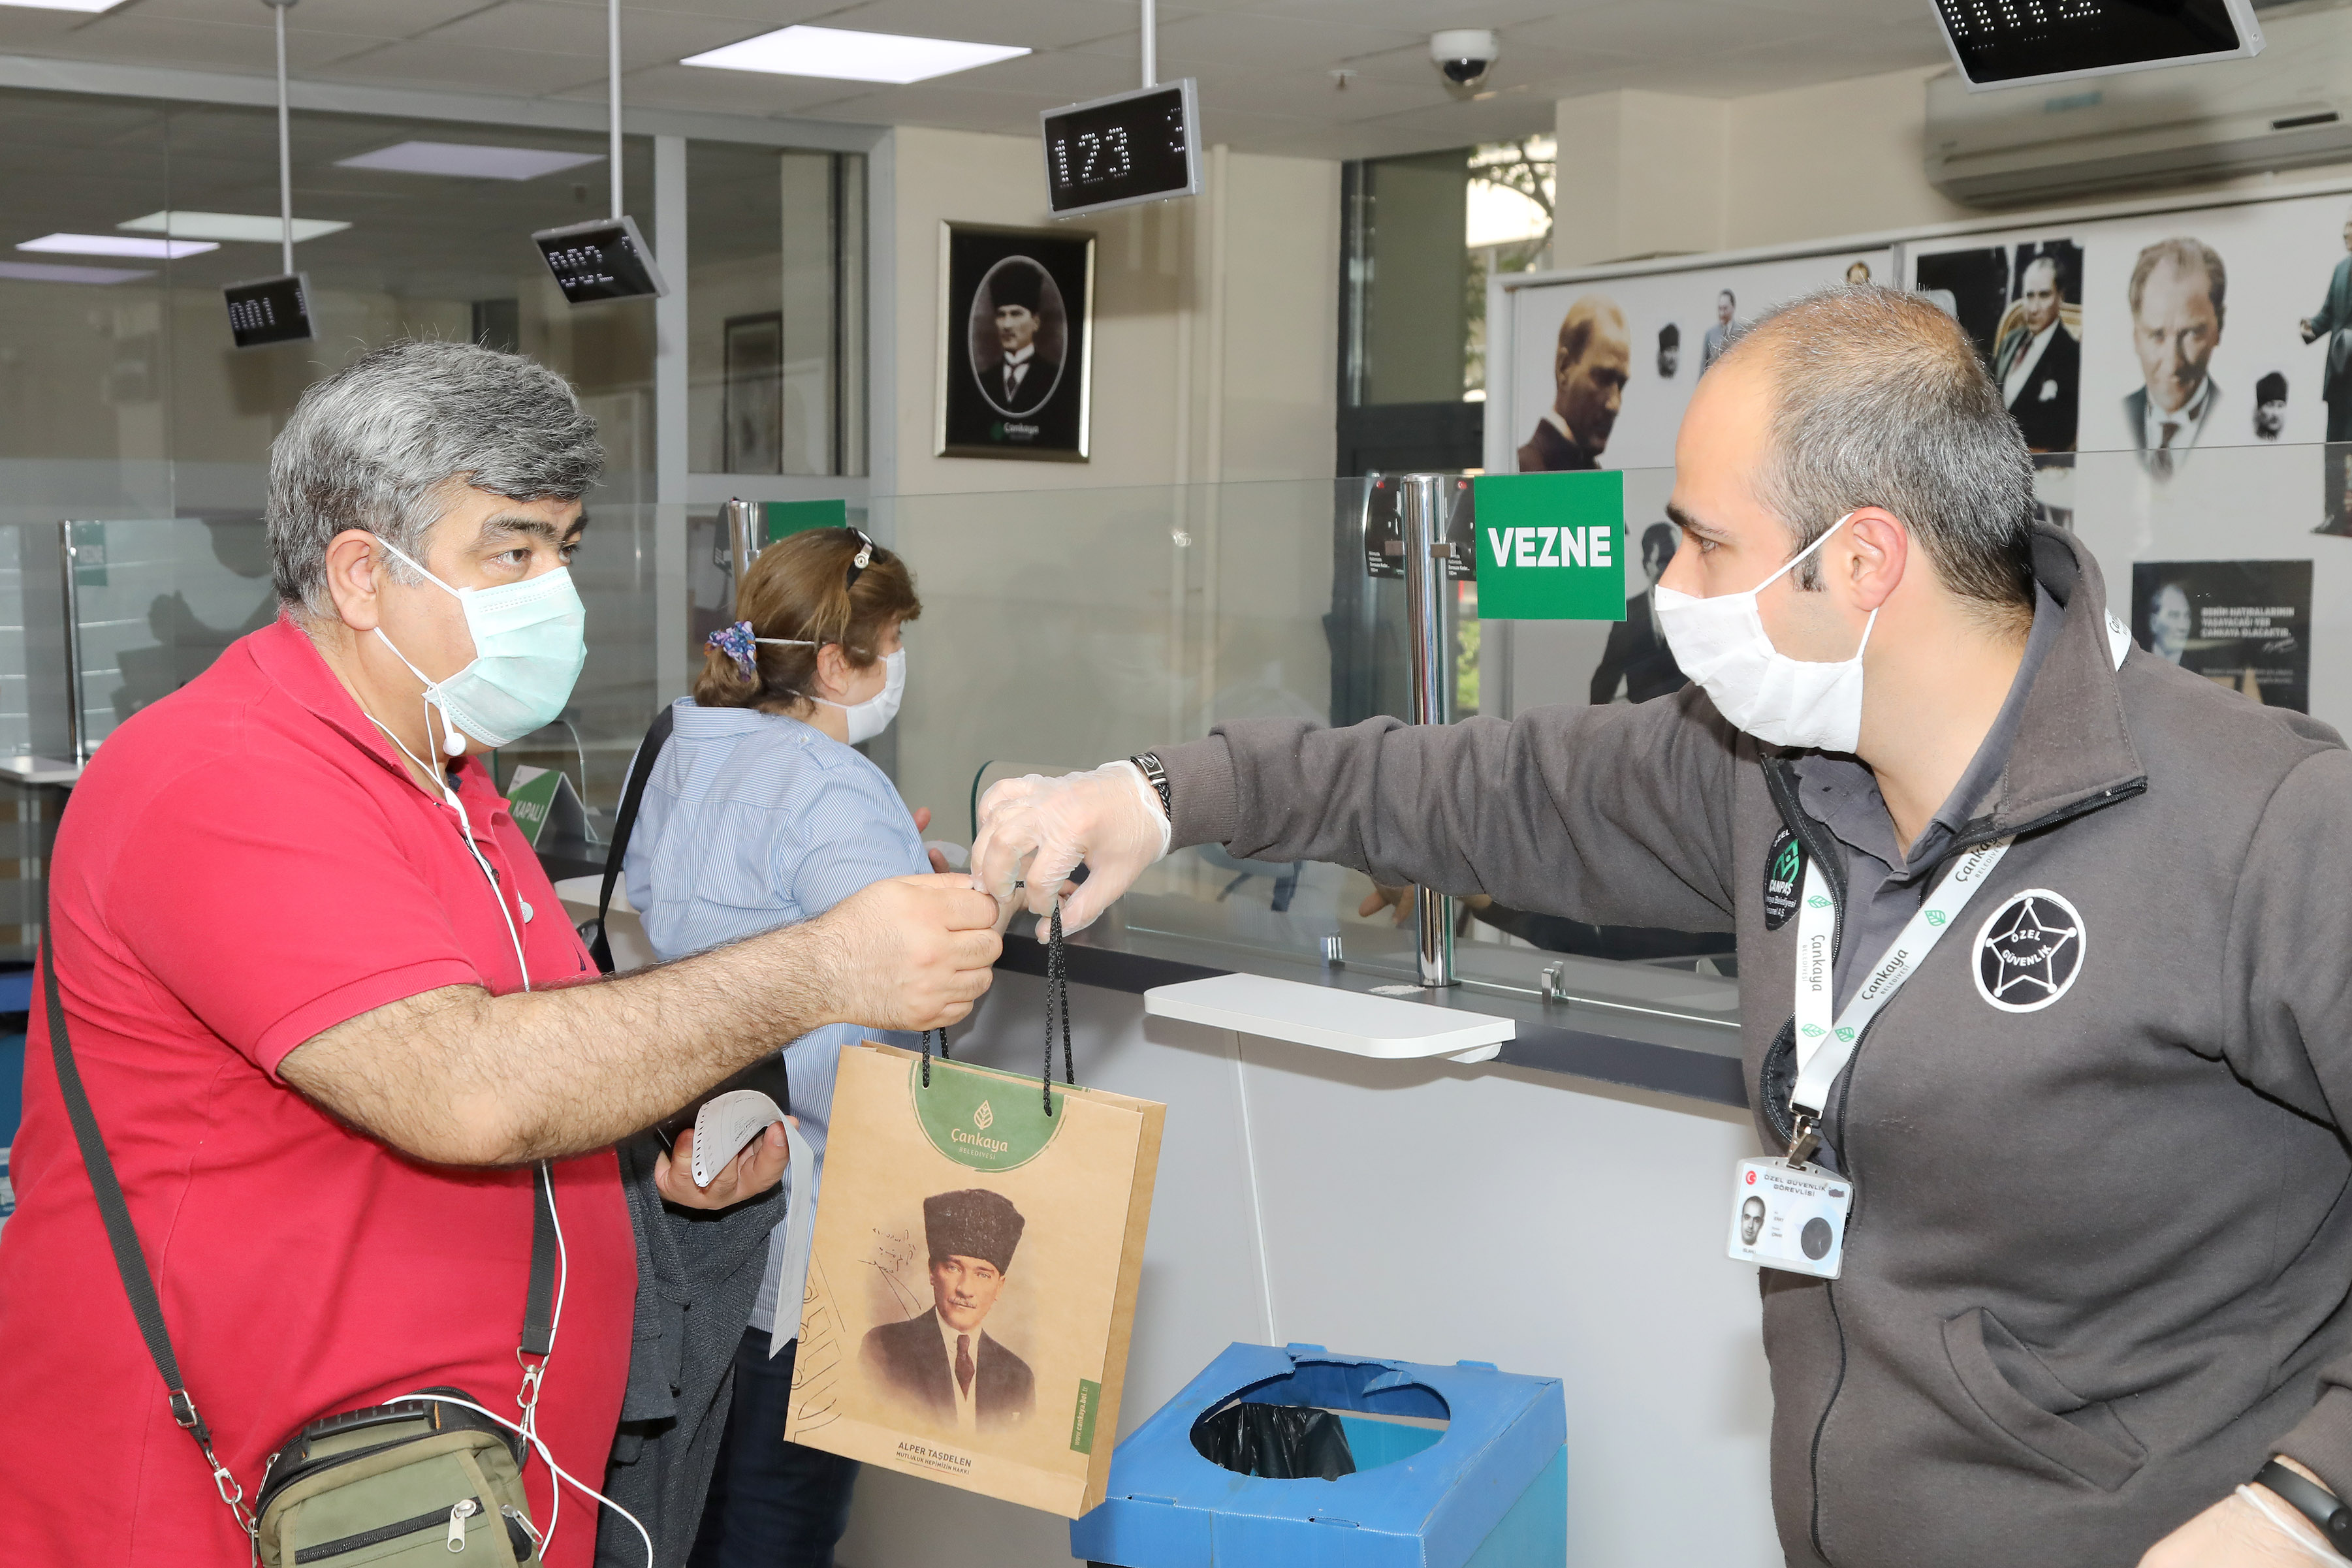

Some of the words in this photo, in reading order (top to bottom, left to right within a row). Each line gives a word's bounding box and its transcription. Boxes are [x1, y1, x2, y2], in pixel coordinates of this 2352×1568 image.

[1055, 126, 1130, 187] 123
[1487, 526, 1612, 567] VEZNE
[512, 800, 545, 822] KAPALI
[2011, 930, 2041, 943] ÖZEL
[1809, 935, 1826, 992] Çankaya
[1862, 949, 1909, 1000] Çankaya
[951, 1128, 1008, 1152] Çankaya
[1764, 1174, 1784, 1183] ÖZEL
[1773, 1184, 1815, 1197] GÖREVLİSİ
[896, 1451, 924, 1463] MUTLULUK
[953, 1466, 970, 1475] HAKKI
[898, 1441, 926, 1455] ALPER
[928, 1449, 972, 1467] TAŞDELEN
